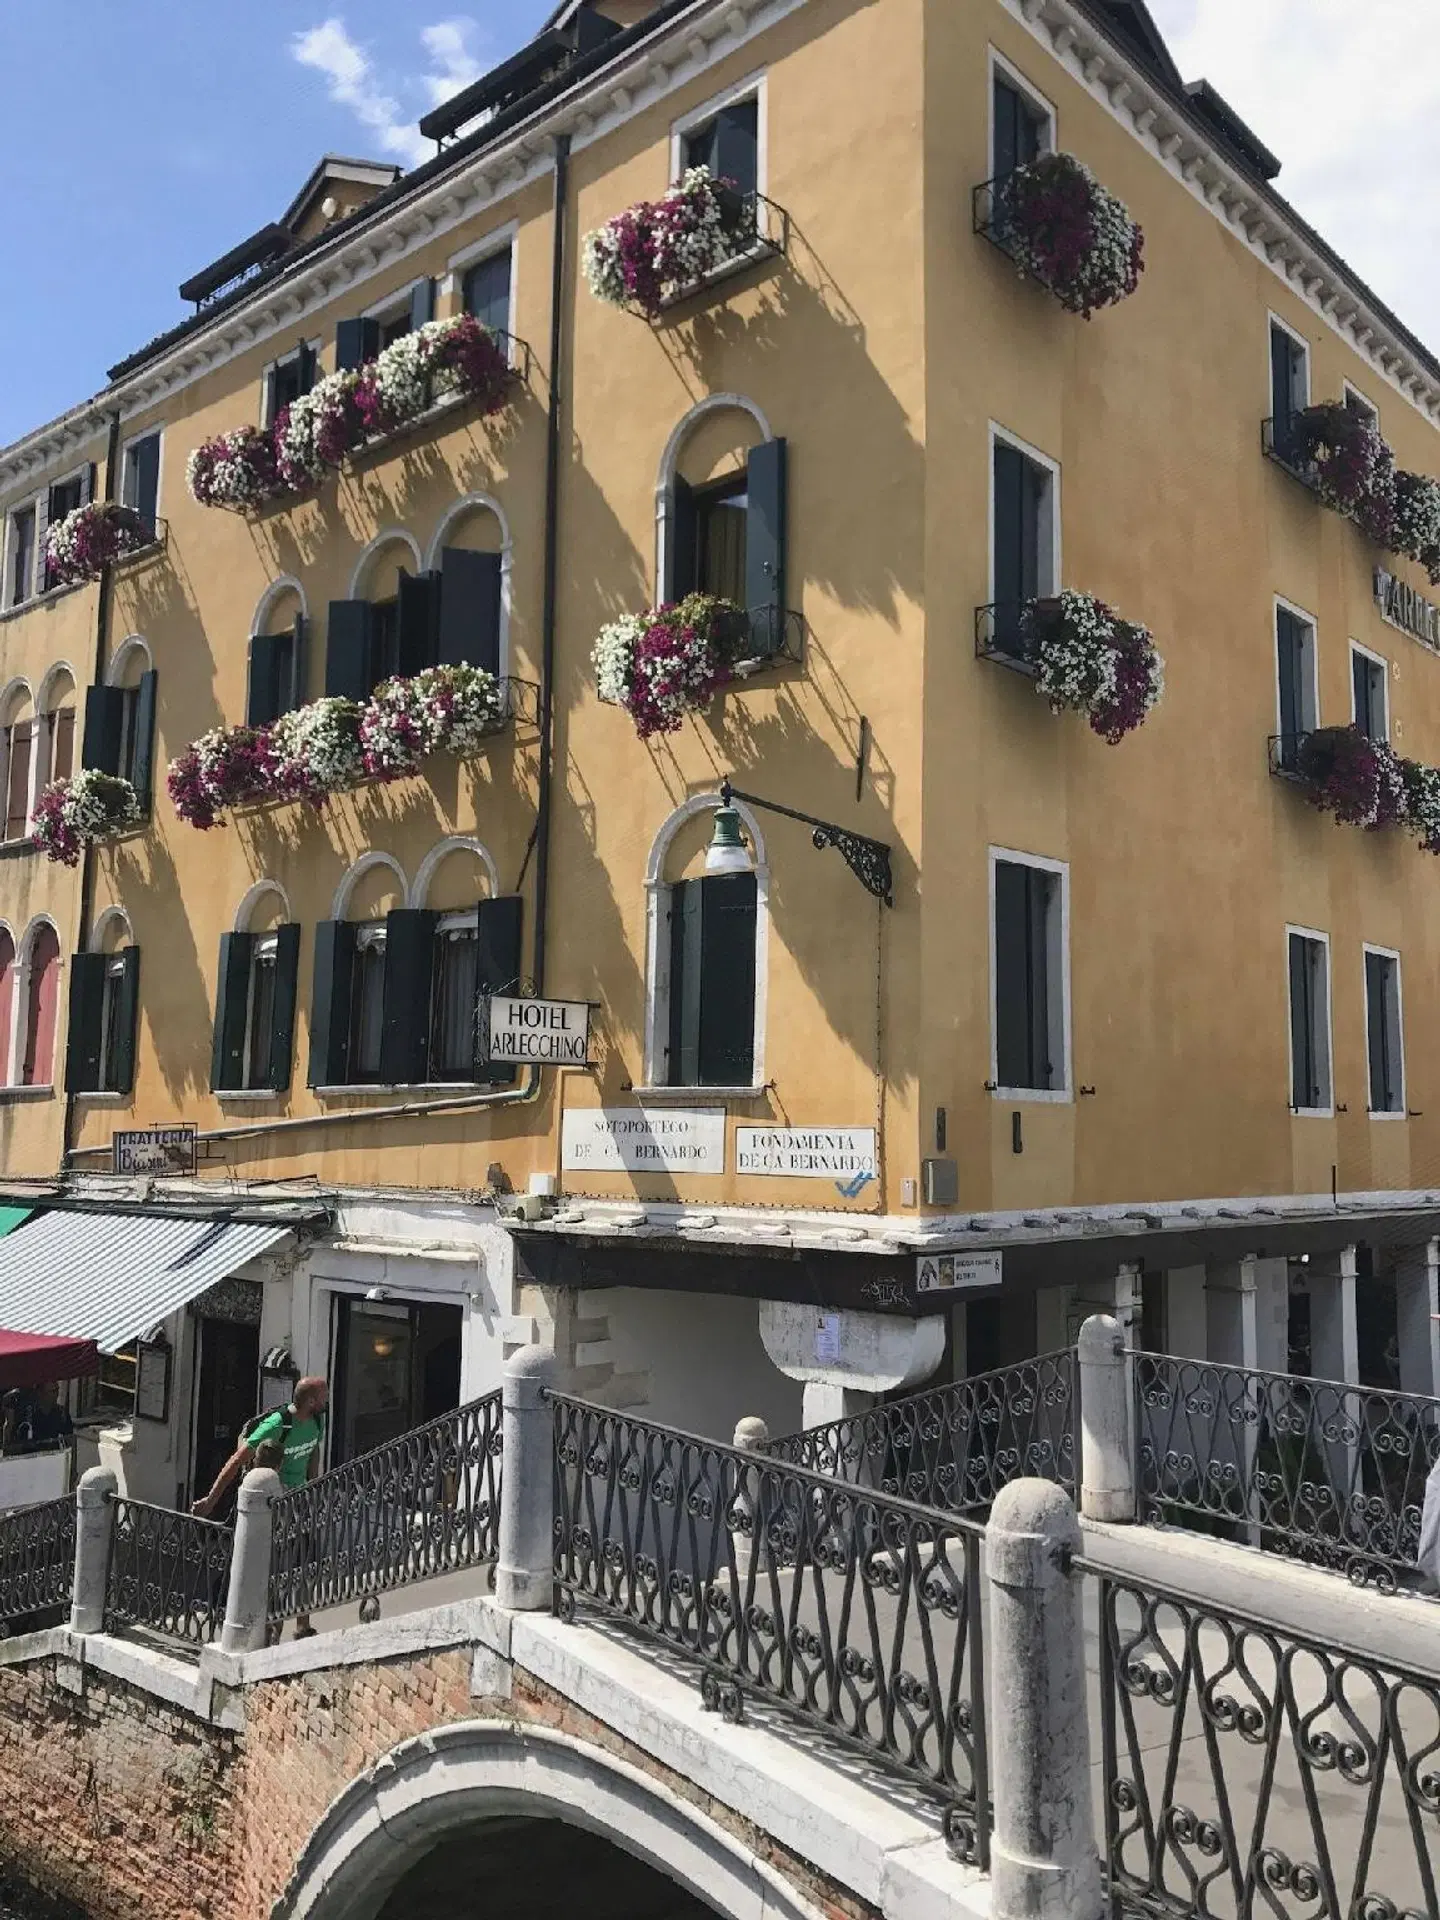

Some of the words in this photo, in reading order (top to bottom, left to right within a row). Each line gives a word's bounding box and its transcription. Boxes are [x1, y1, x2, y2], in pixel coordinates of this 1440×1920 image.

[508, 1004, 572, 1030] HOTEL
[491, 1032, 585, 1059] ARLECCHINO
[752, 1134, 855, 1150] FONDAMENTA
[574, 1143, 592, 1158] DE
[635, 1144, 708, 1160] BERNARDO
[739, 1152, 760, 1168] DE
[790, 1154, 873, 1170] BERNARDO
